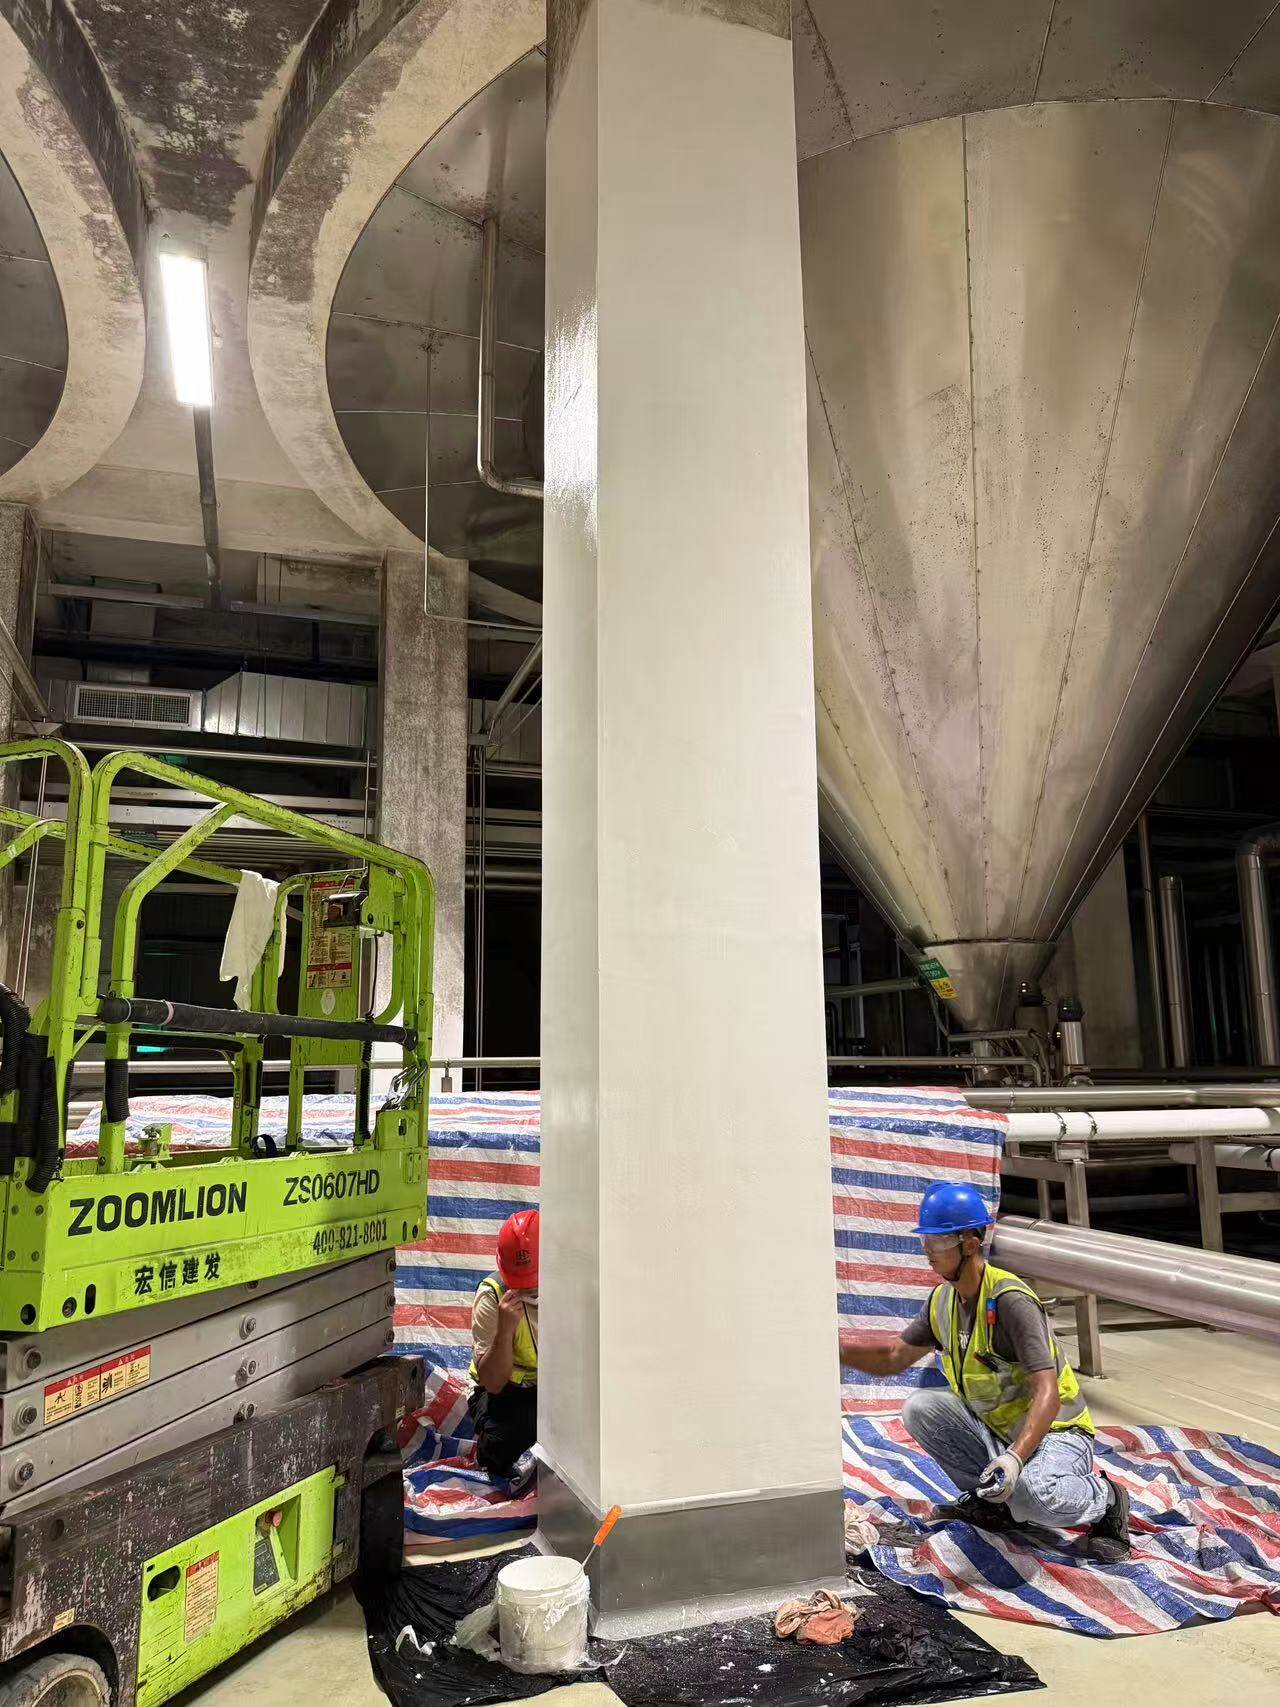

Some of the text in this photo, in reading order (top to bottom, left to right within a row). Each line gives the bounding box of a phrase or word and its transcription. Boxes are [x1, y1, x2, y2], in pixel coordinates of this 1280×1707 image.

[283, 1169, 380, 1206] ZS0607HD
[68, 1182, 247, 1236] ZOOMLION
[313, 1219, 387, 1255] 400-821-8001
[134, 1252, 221, 1295] 宏信建发
